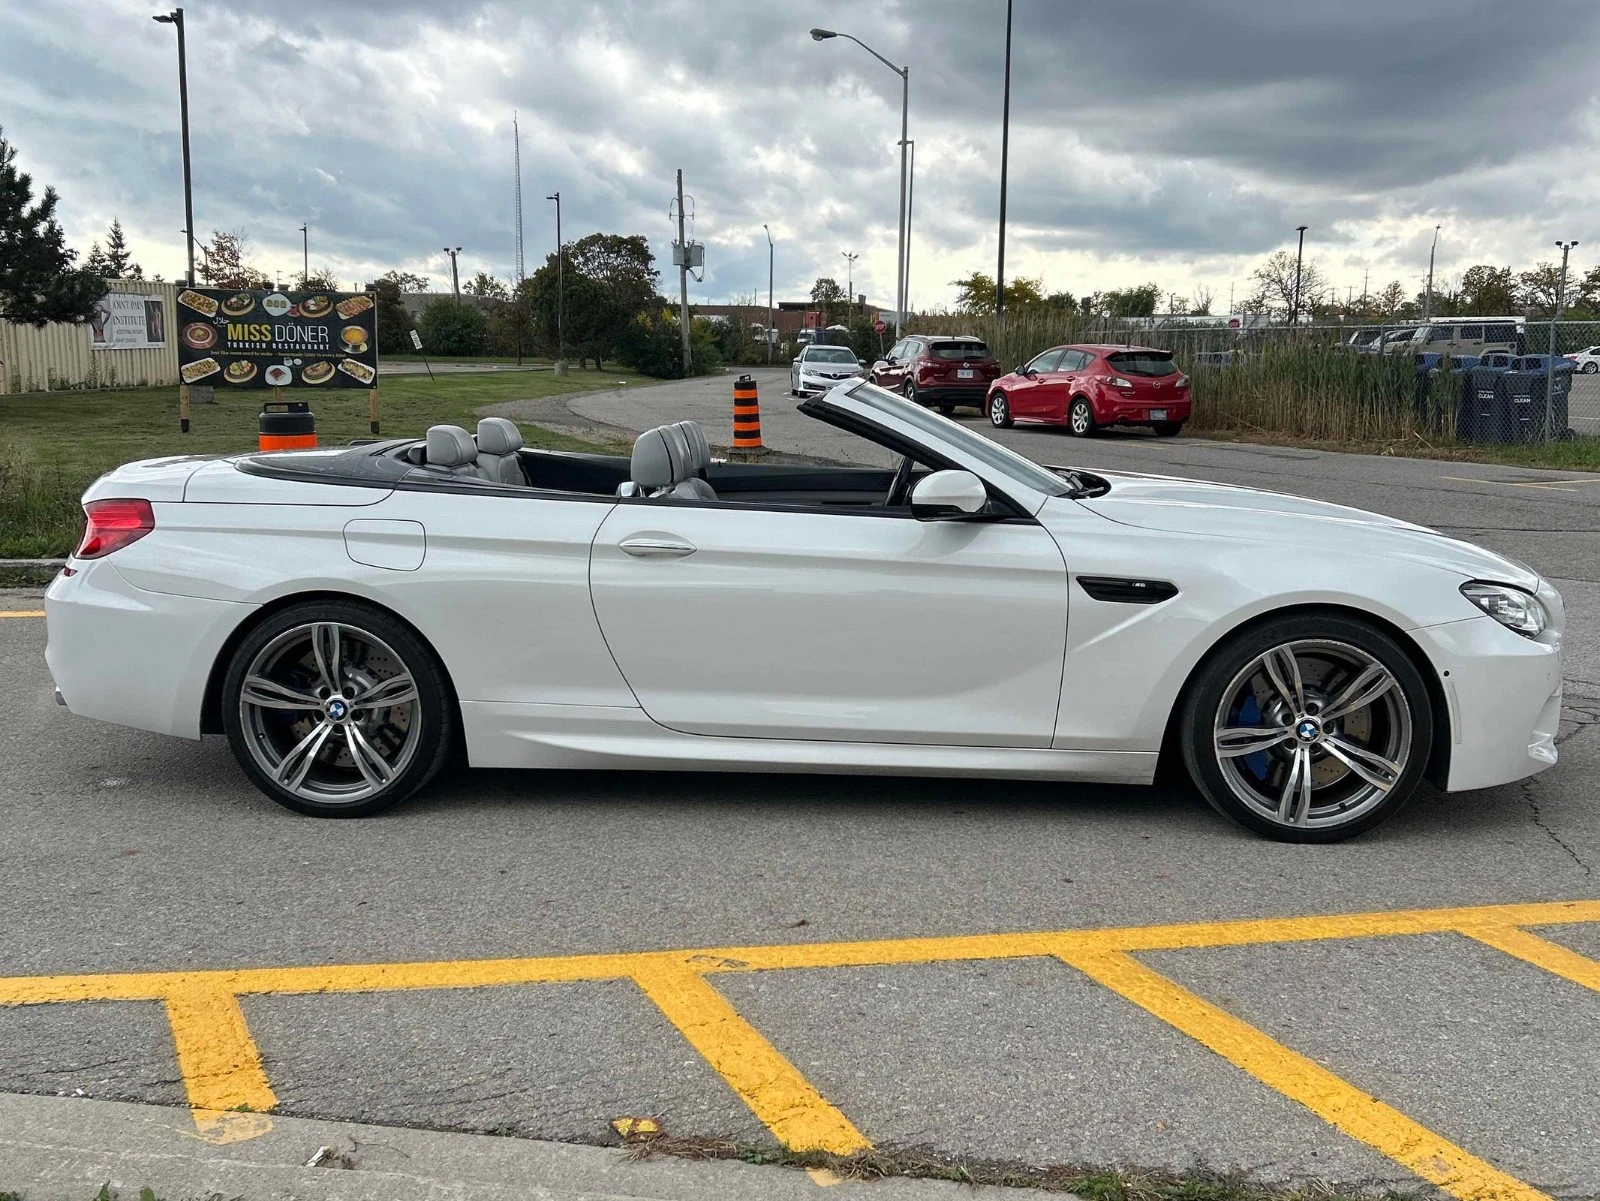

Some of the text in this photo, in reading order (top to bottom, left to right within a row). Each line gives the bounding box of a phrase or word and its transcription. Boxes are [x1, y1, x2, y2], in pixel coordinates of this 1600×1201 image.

[112, 315, 145, 325] INSTITUTE
[227, 322, 329, 343] MISS DÖNER
[227, 341, 330, 351] TURKISH RESTAURANT
